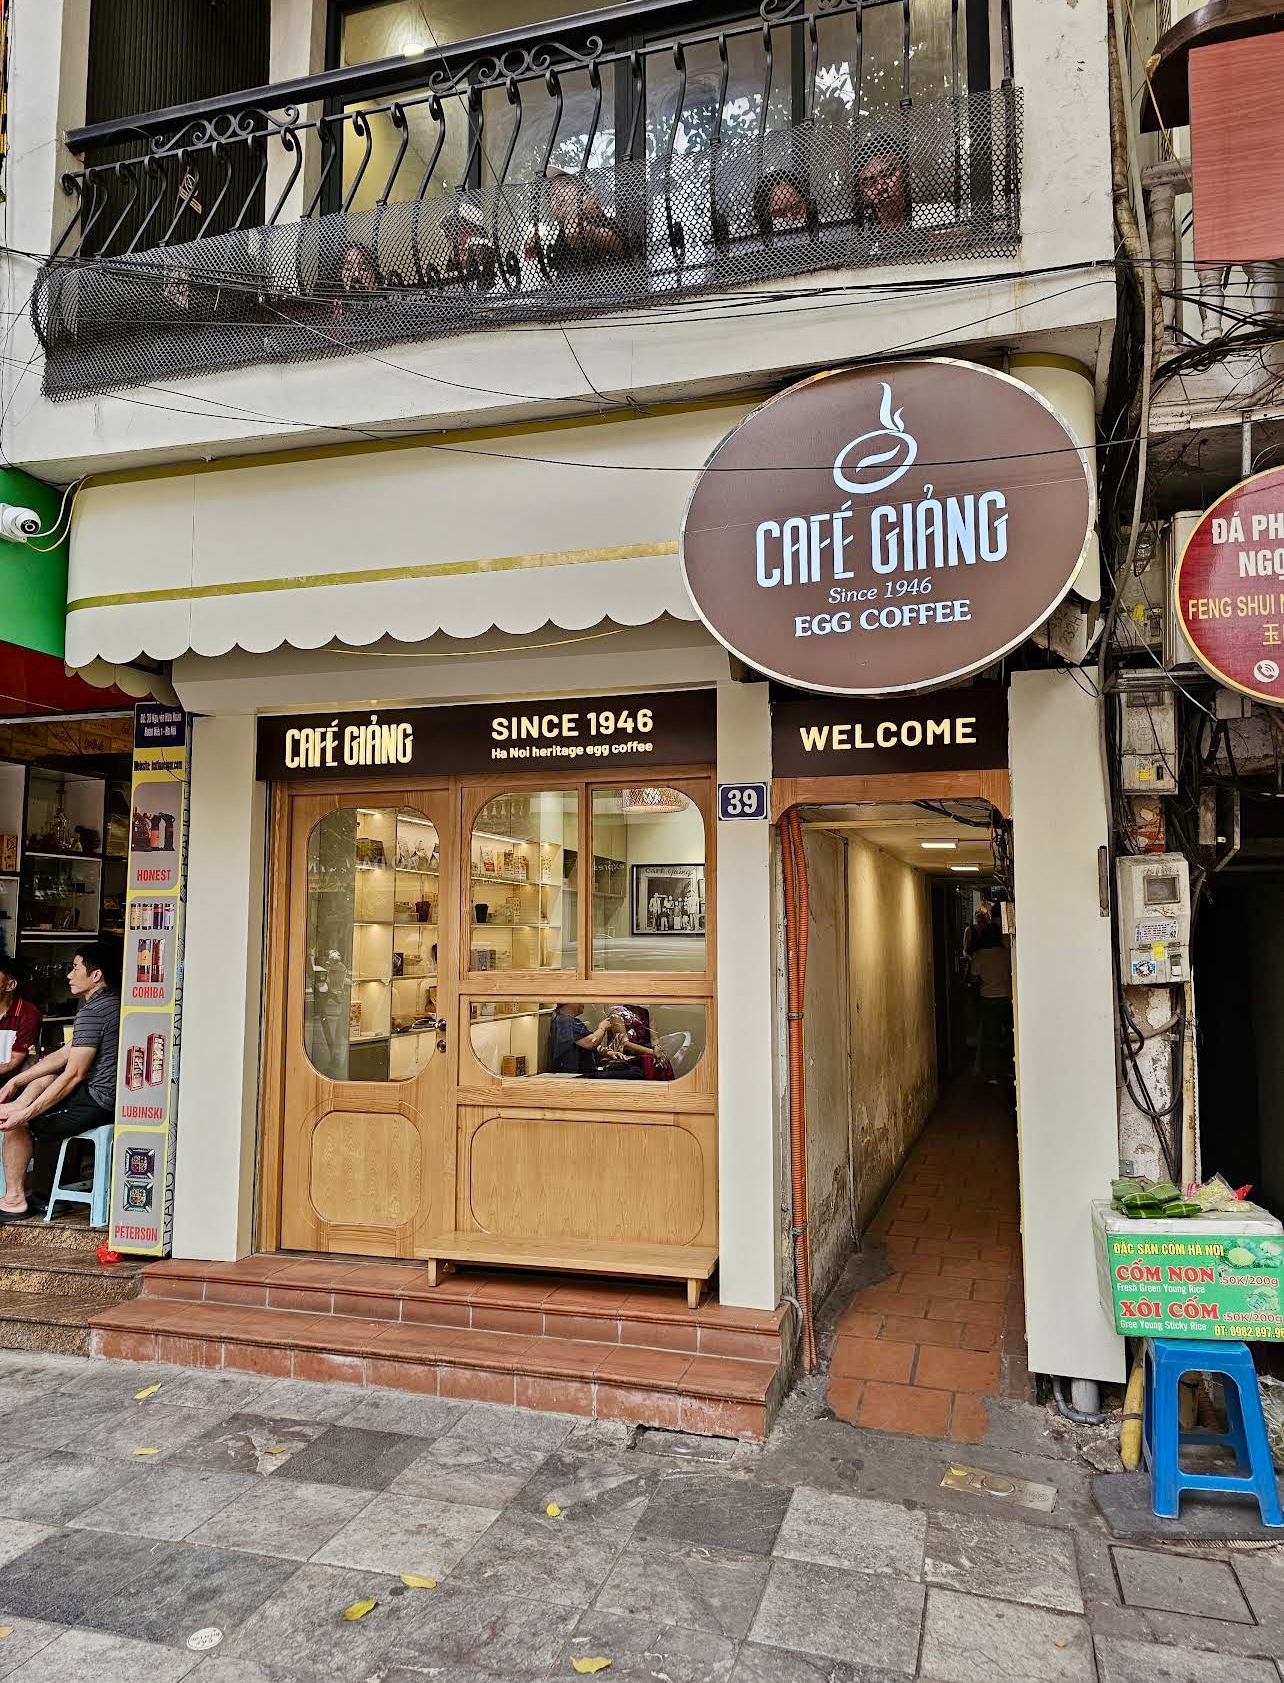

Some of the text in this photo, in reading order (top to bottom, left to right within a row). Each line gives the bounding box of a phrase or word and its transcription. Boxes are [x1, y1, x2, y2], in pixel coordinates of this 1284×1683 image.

[756, 484, 1008, 588] CAFÉ GIẢNG
[1211, 511, 1245, 545] ĐÁ
[829, 577, 932, 604] Since 1946
[794, 600, 972, 637] EGG COFFEE
[1188, 597, 1232, 620] FENG
[1236, 594, 1275, 617] SHUI
[1262, 623, 1284, 645] 玉
[491, 709, 654, 741] SINCE 1946
[800, 717, 977, 752] WELCOME
[285, 714, 414, 769] CAFÉ GIẢNG
[491, 741, 654, 759] Ha Noi heritage egg coffee
[727, 788, 758, 815] 39
[136, 869, 172, 882] HONEST
[132, 986, 165, 999] COHIBA
[121, 1106, 163, 1120] LUBINSKI
[114, 1224, 158, 1242] PETERSON
[1187, 1241, 1202, 1256] HÀ
[1205, 1243, 1224, 1258] NỘI
[1116, 1258, 1215, 1283] CỐM NON
[1116, 1282, 1206, 1295] Fresh Green Young Rice
[1119, 1295, 1219, 1320] XÔI CỐM
[1119, 1320, 1207, 1331] Gree Young Sticky Rice
